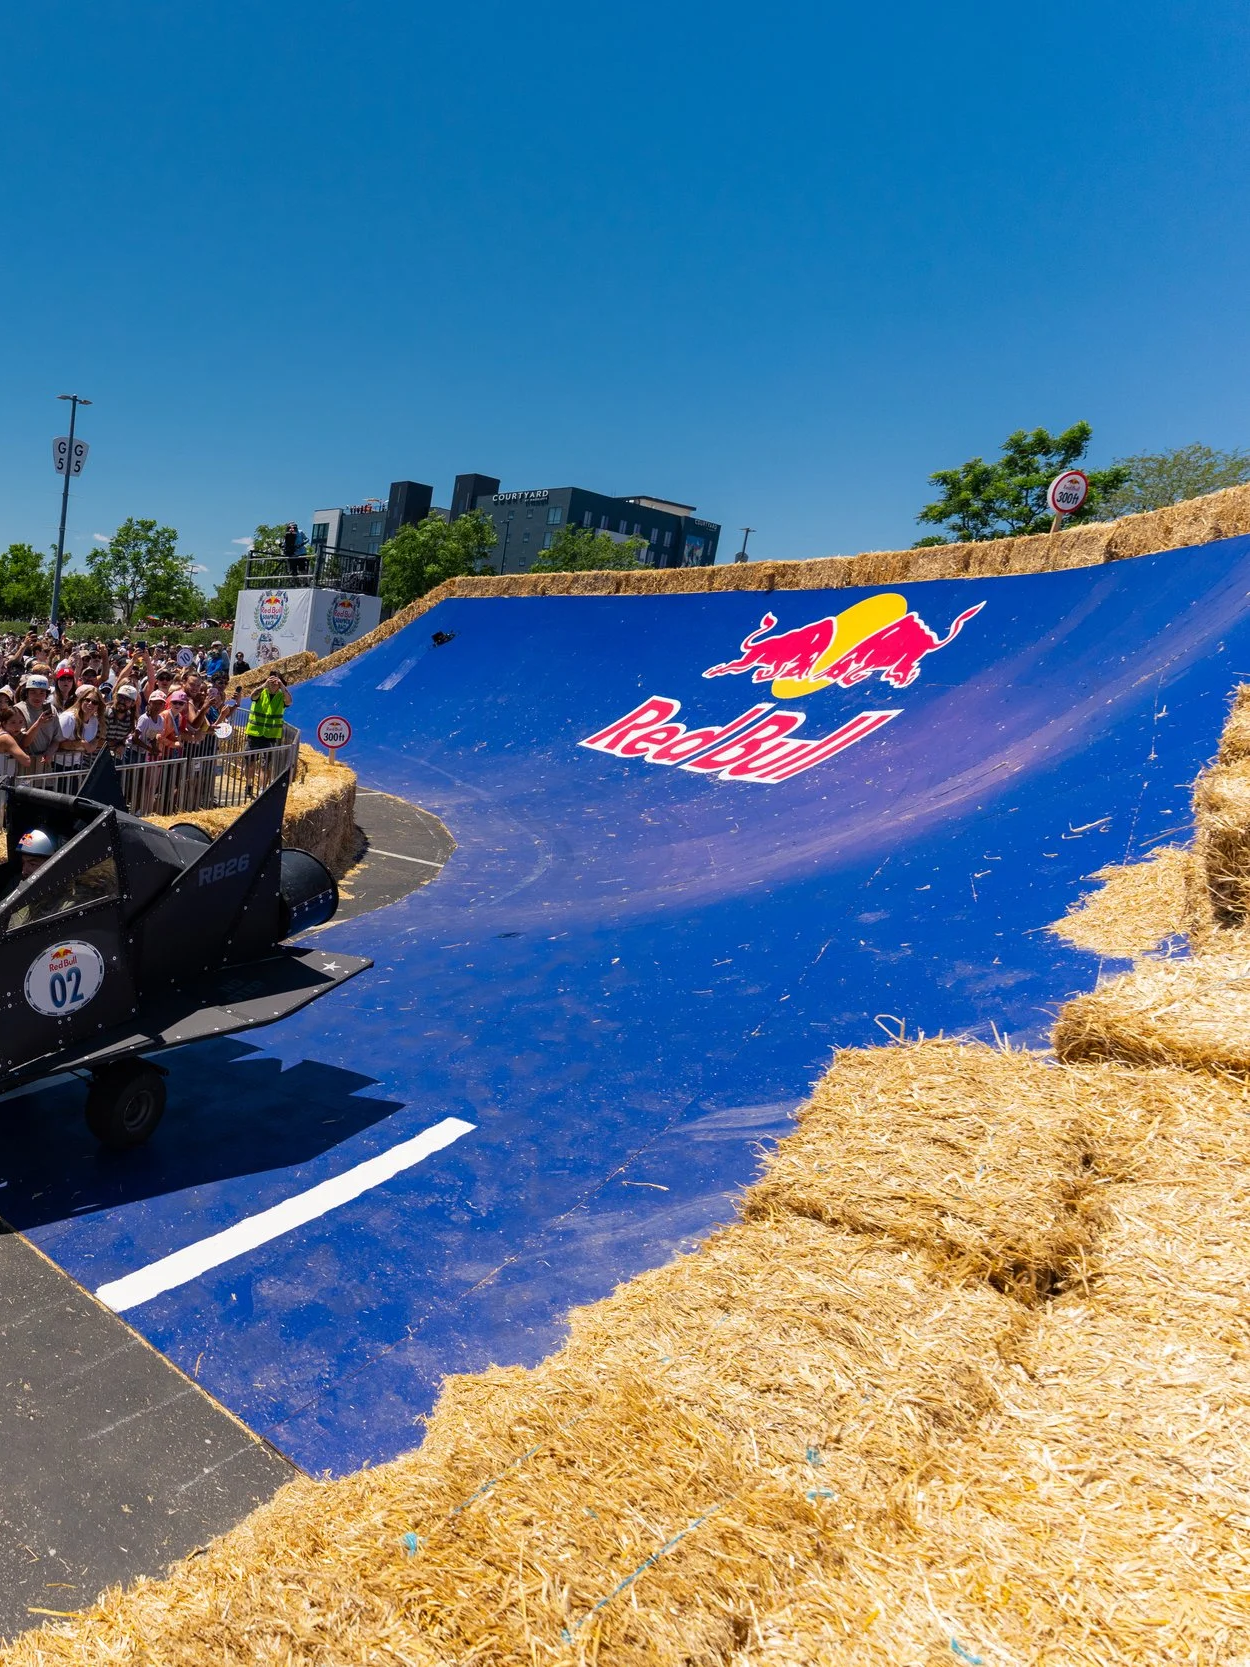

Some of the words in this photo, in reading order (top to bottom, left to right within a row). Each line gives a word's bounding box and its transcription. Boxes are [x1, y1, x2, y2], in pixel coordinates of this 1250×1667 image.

[58, 441, 67, 454] G
[74, 444, 84, 457] G
[56, 457, 65, 470] 5
[73, 460, 81, 473] 5
[492, 490, 549, 502] COURTYARD
[1056, 491, 1080, 505] 300ft
[261, 606, 271, 614] Red
[271, 606, 283, 614] Bull
[180, 652, 191, 664] 10
[323, 732, 345, 742] 300ft
[577, 695, 778, 766] Red
[677, 710, 905, 784] Bull
[199, 853, 250, 887] RB26
[49, 960, 63, 972] Red
[64, 955, 78, 967] Bull
[50, 966, 85, 1009] 02
